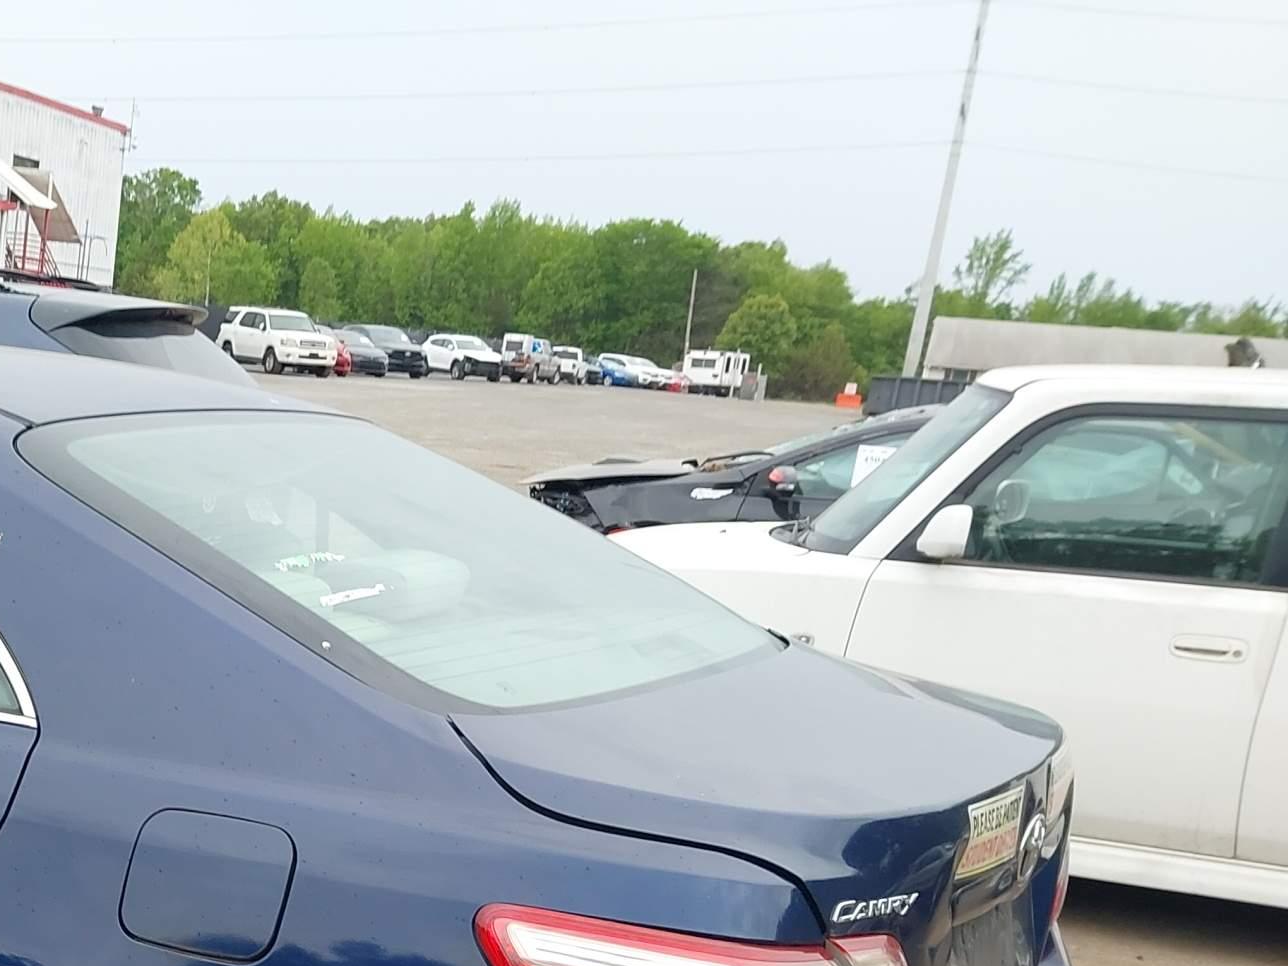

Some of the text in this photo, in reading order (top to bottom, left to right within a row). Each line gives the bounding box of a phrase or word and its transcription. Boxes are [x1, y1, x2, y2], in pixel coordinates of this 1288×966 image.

[972, 808, 995, 838] PLEASE
[995, 805, 1003, 828] BE
[831, 892, 920, 923] CAMRY
